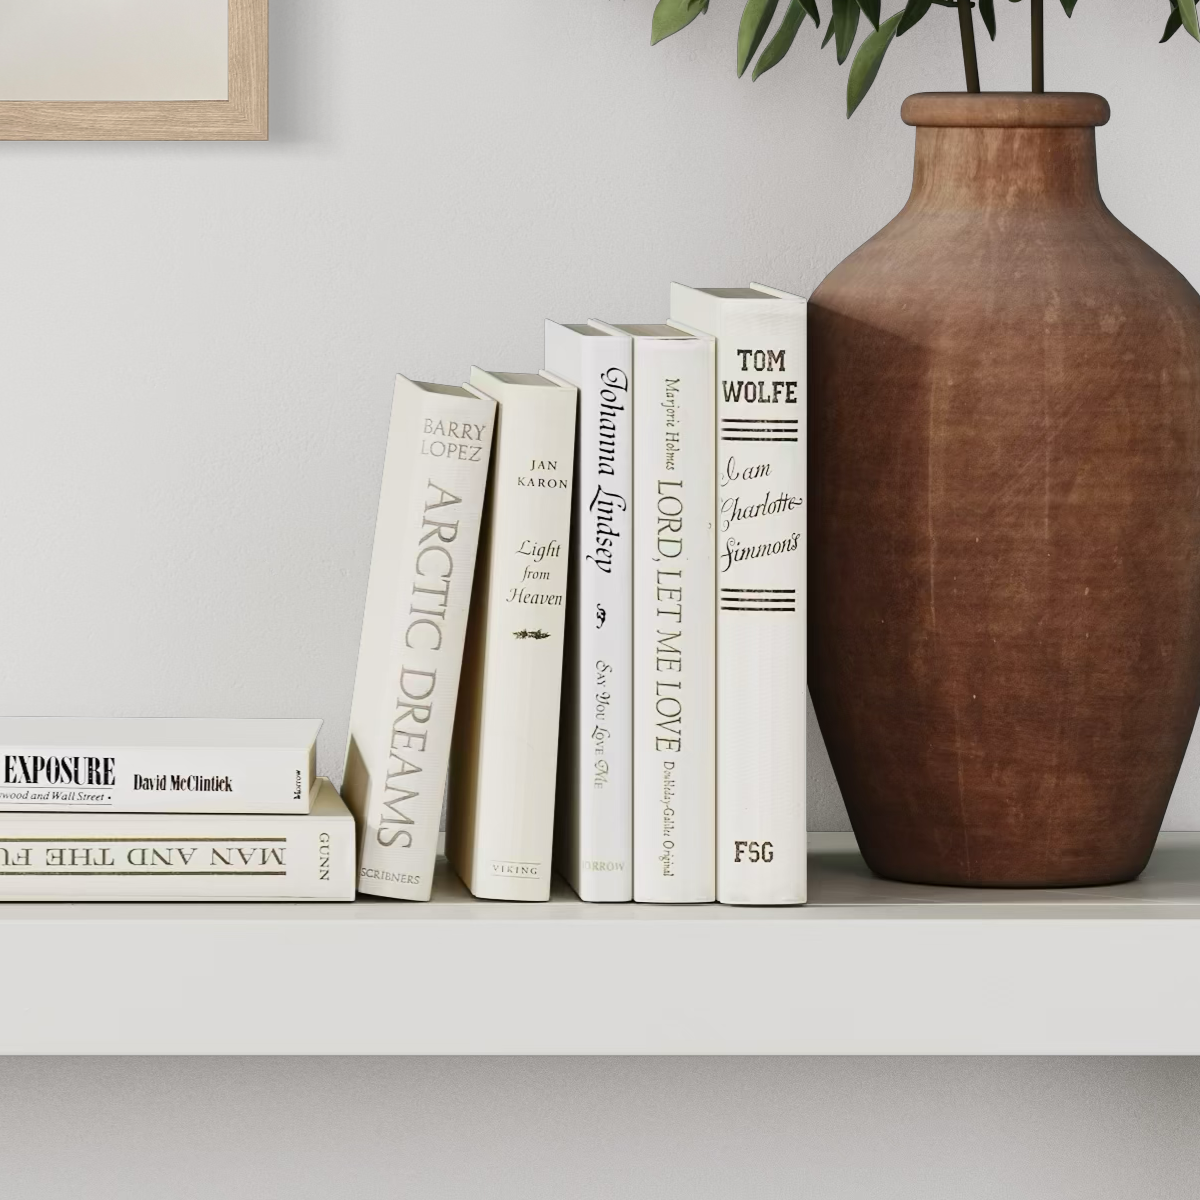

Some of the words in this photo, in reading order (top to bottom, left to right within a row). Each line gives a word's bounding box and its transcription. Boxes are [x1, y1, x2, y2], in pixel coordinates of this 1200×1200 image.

[737, 349, 785, 372] TOM
[661, 379, 680, 427] Marjorie
[722, 381, 797, 403] WOLFE
[423, 419, 486, 442] BARRY
[598, 367, 628, 475] Johanna
[421, 440, 483, 462] LOPEZ
[666, 432, 680, 470] Holmes
[530, 460, 557, 471] JAN
[743, 464, 772, 480] am
[518, 477, 567, 488] KARON
[652, 480, 683, 561] LORD,
[721, 491, 802, 534] Charlotte
[586, 484, 626, 573] Lindsey
[516, 540, 560, 562] Light
[405, 478, 463, 651] ARCTIC
[522, 565, 550, 582] from
[506, 588, 562, 605] Heaven
[657, 570, 682, 623] LET
[656, 630, 681, 672] ME
[656, 681, 681, 752] LOVE
[377, 664, 438, 849] DREAMS
[4, 756, 115, 785] EXPOSURE
[134, 774, 166, 790] David
[170, 775, 232, 792] McClintick
[293, 770, 301, 799] Morrow
[30, 792, 50, 800] and
[52, 792, 75, 800] Wall
[77, 792, 104, 801] Street
[46, 848, 114, 866] THE
[127, 848, 198, 865] AND
[210, 848, 286, 865] MAN
[319, 833, 330, 880] GUNN
[659, 841, 674, 876] Original
[734, 841, 773, 862] FSG
[360, 867, 421, 885] SCRIBNERS
[492, 864, 538, 875] VIKING
[582, 861, 626, 871] ORROW
